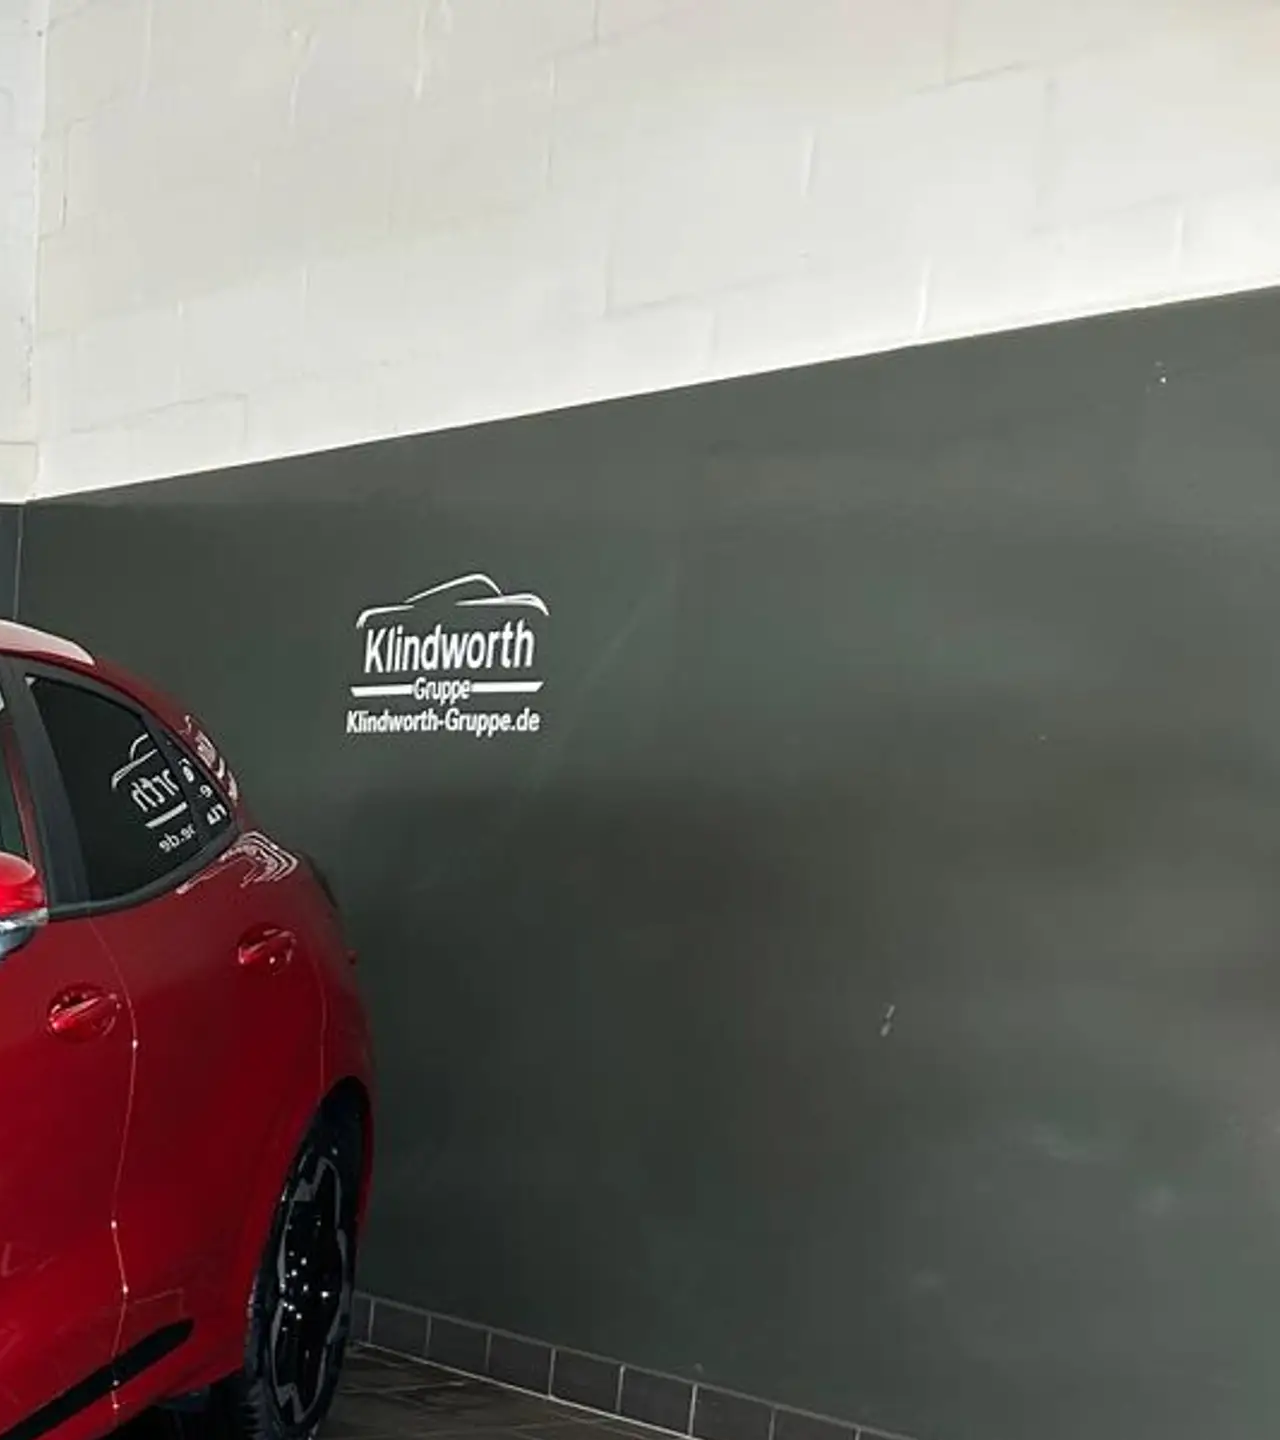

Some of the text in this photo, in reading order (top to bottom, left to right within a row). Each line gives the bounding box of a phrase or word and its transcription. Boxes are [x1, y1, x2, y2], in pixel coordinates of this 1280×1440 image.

[364, 618, 535, 673] Klindworth
[412, 676, 472, 706] Gruppe
[346, 706, 540, 738] Klindworth-Gruppe.de
